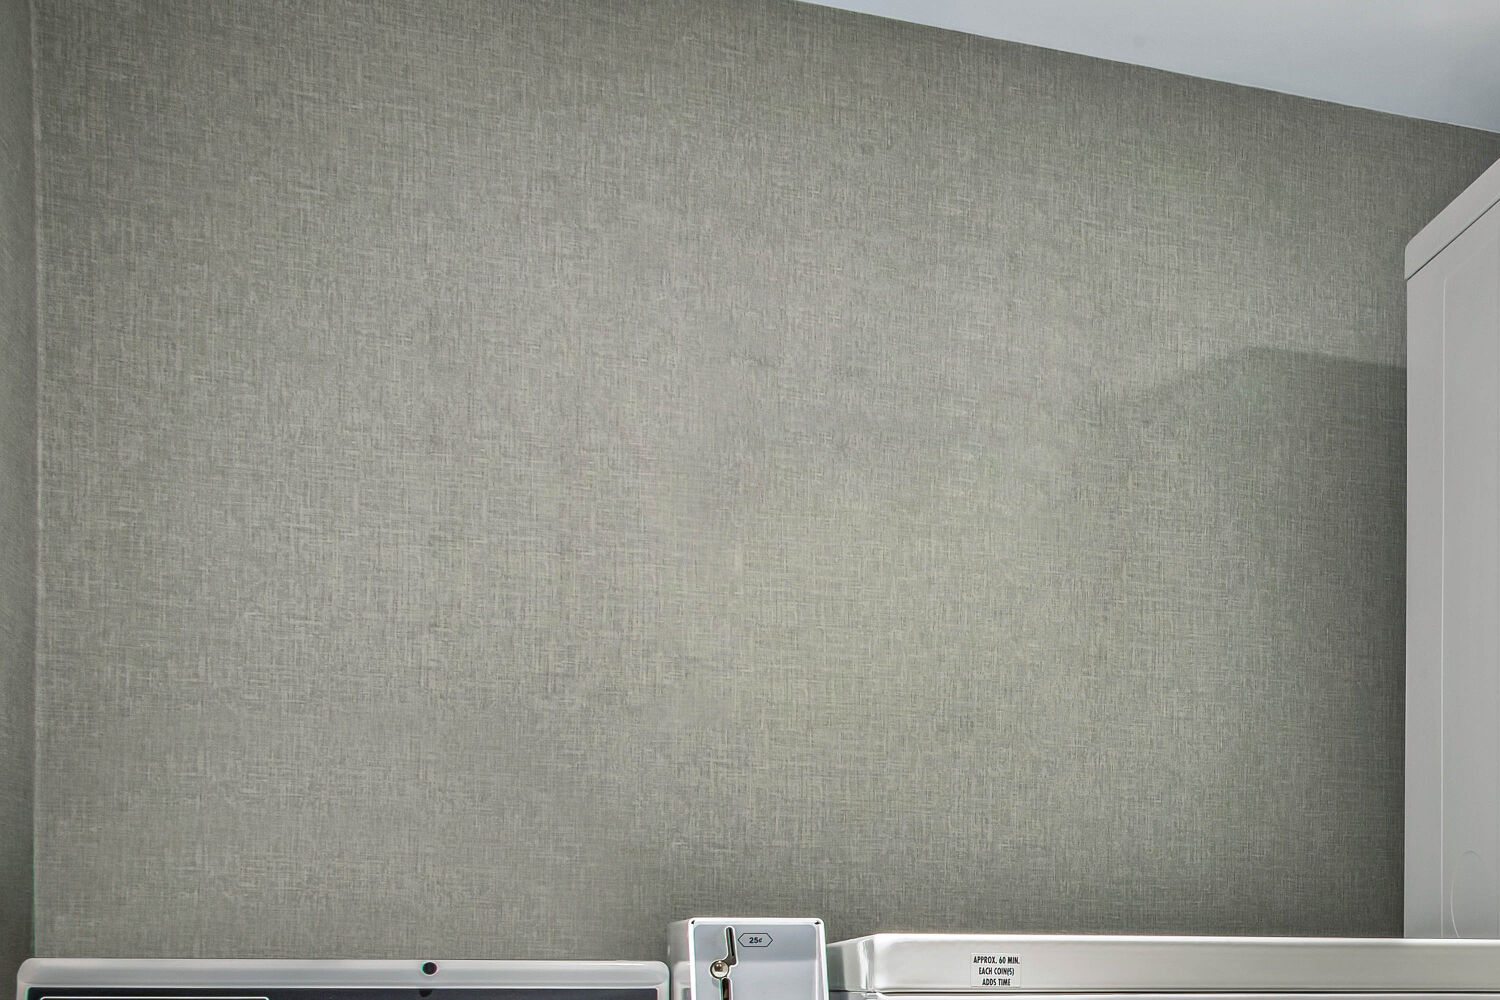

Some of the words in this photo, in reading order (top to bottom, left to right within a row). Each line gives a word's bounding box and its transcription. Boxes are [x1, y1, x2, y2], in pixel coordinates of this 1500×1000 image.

[973, 956, 997, 964] APPROX.
[979, 967, 992, 975] EACH
[994, 968, 1014, 976] COIN(S)
